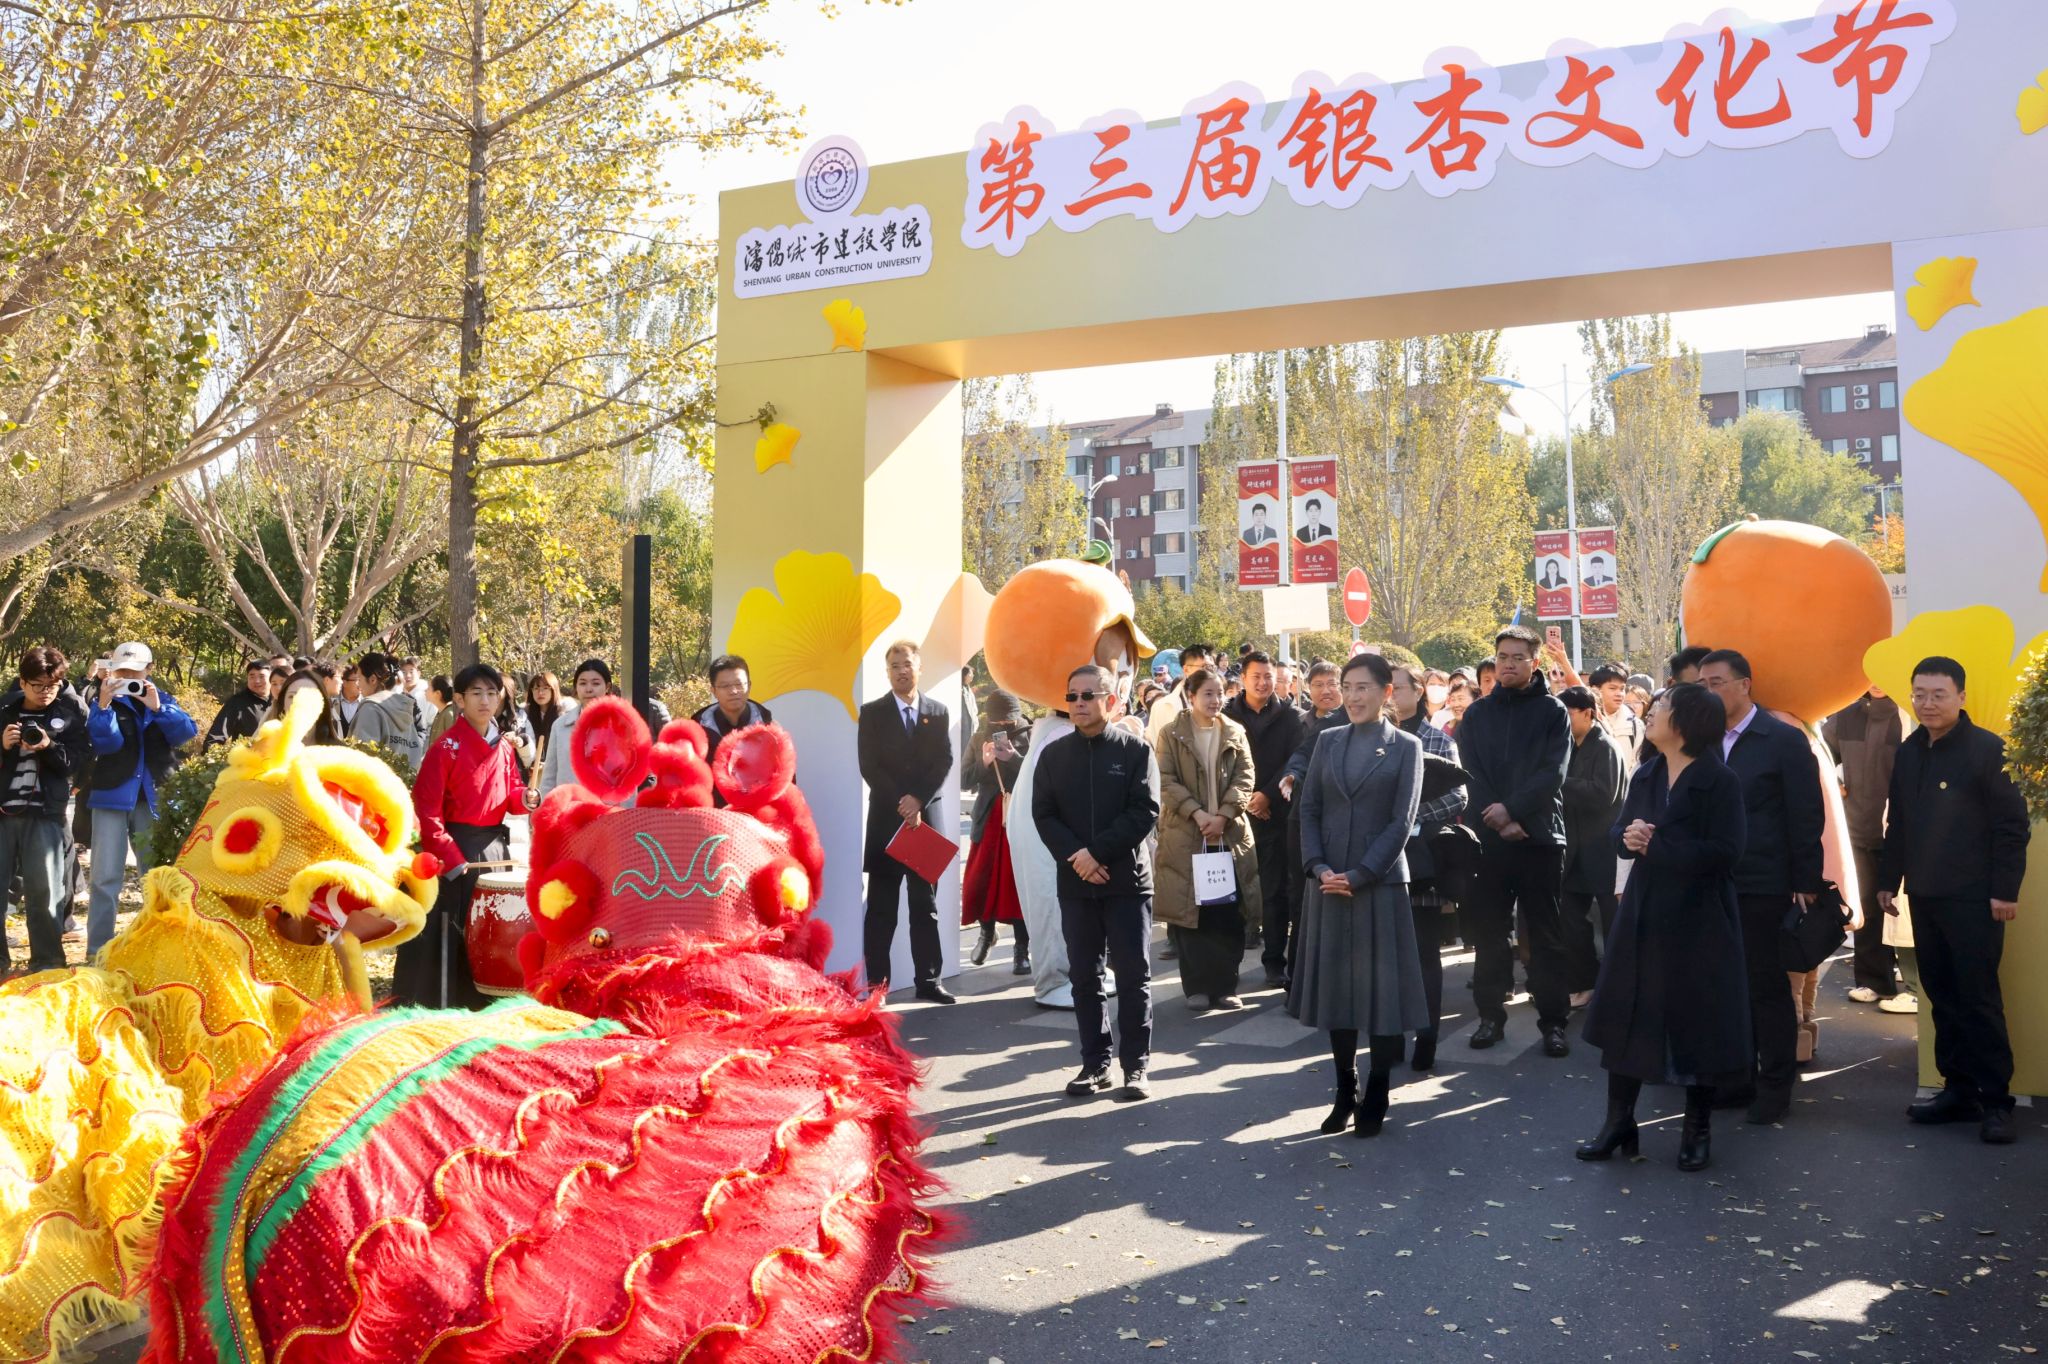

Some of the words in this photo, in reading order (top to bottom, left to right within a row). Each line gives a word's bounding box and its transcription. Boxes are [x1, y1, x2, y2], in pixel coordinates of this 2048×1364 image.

[976, 0, 1934, 240] 第三届银杏文化节
[743, 275, 782, 288] SHENYANG
[785, 271, 811, 281] URBAN
[814, 262, 873, 278] CONSTRUCTION
[877, 256, 922, 270] UNIVERSITY
